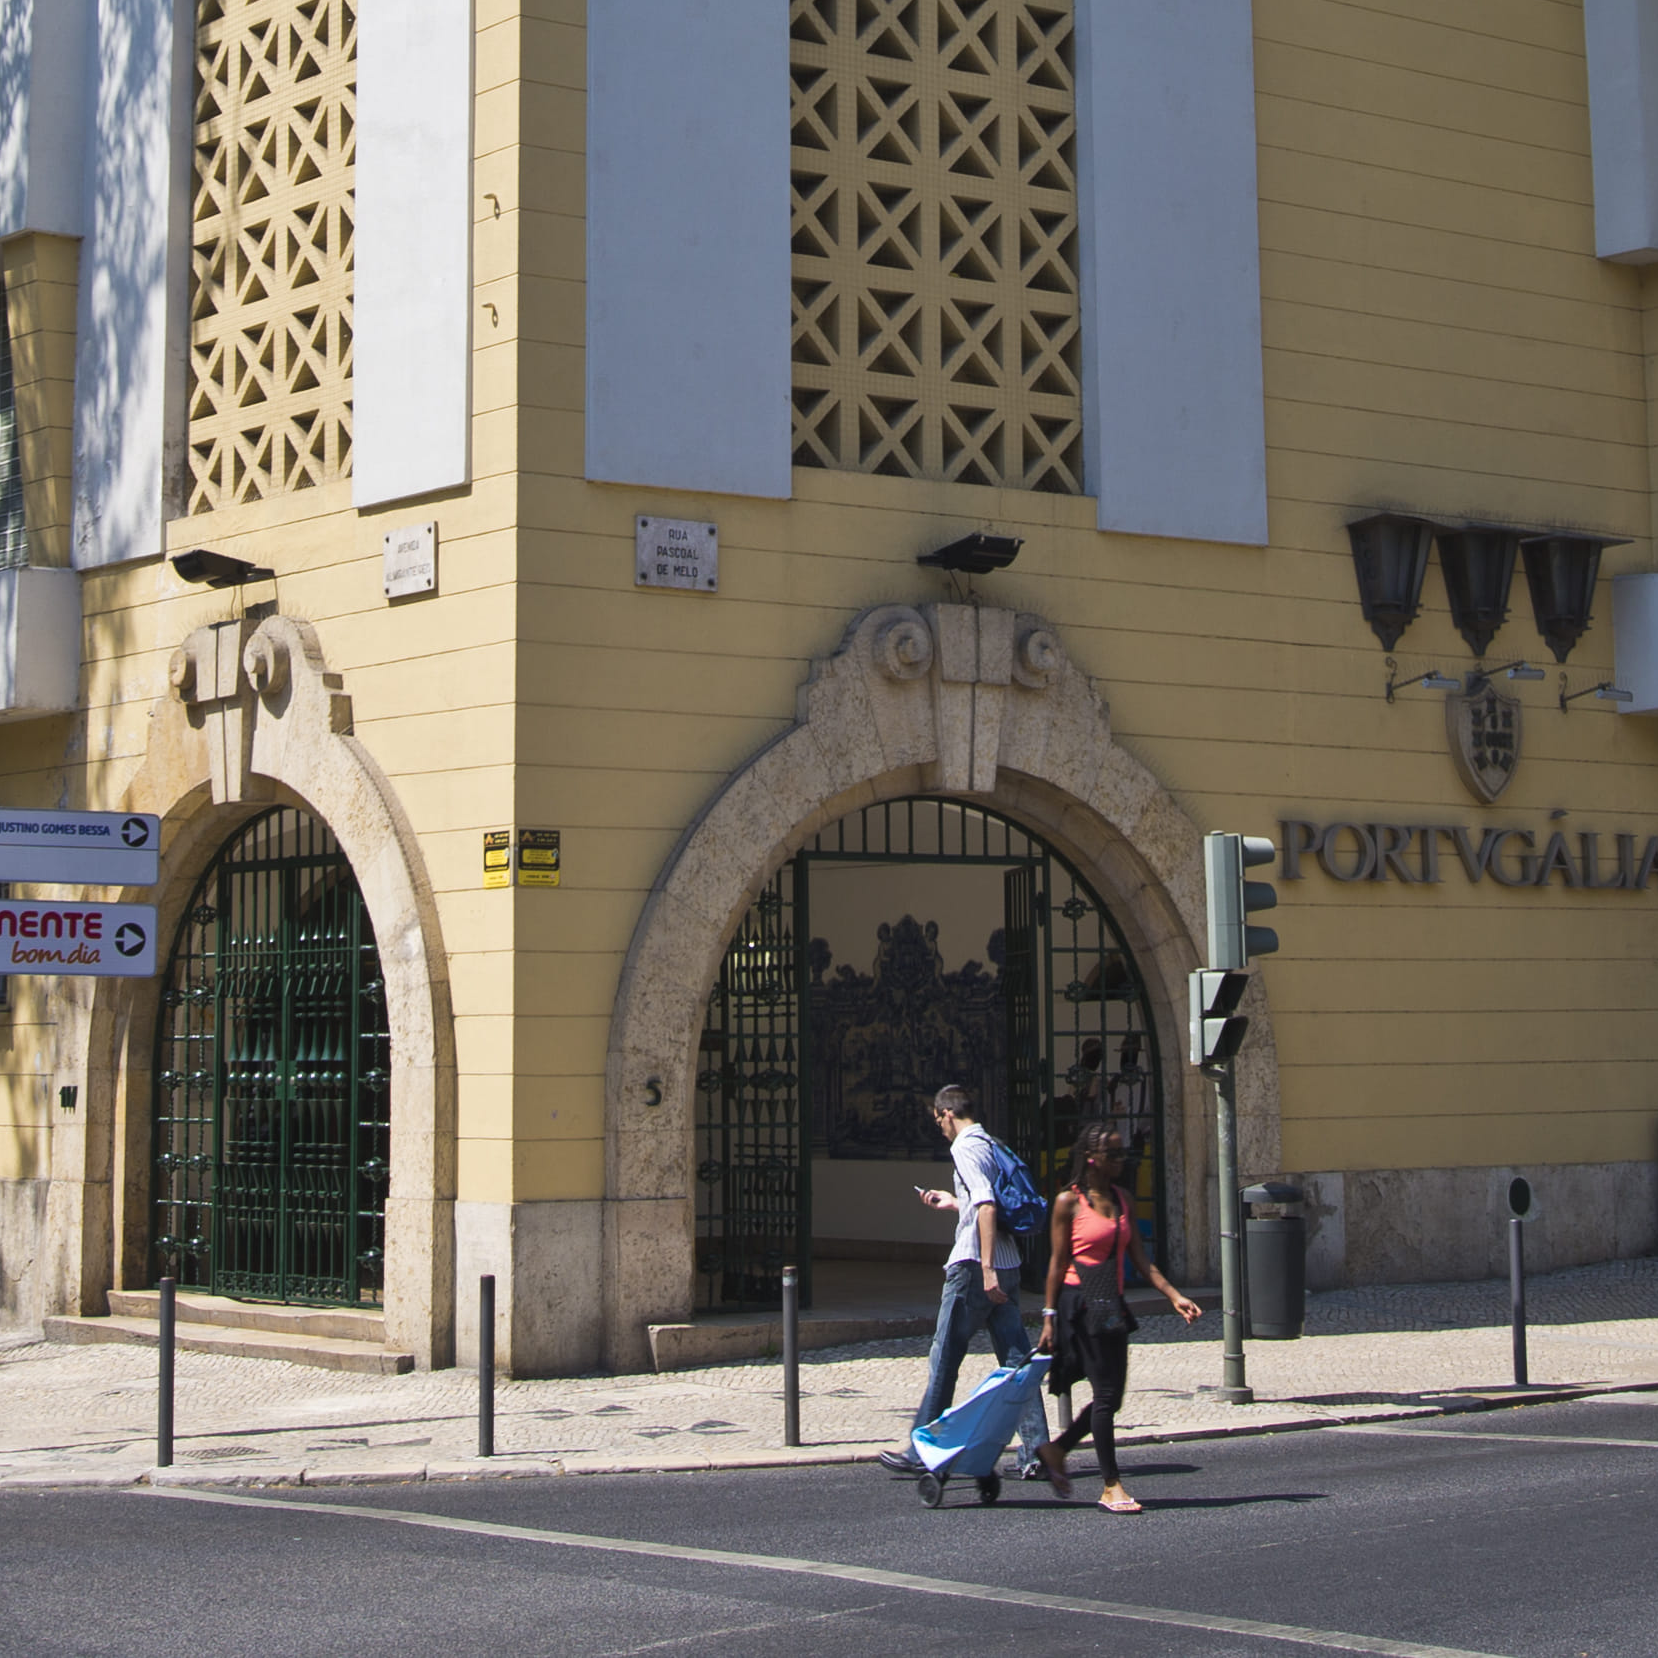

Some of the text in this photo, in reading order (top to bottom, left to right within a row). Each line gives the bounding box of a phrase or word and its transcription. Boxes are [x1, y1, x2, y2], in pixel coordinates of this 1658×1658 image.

[668, 528, 688, 541] RUA
[656, 545, 700, 560] PASCOAL
[656, 564, 699, 578] DE MELO
[41, 823, 77, 835] GOMES
[78, 824, 111, 837] BESSA
[11, 941, 101, 965] bom dia
